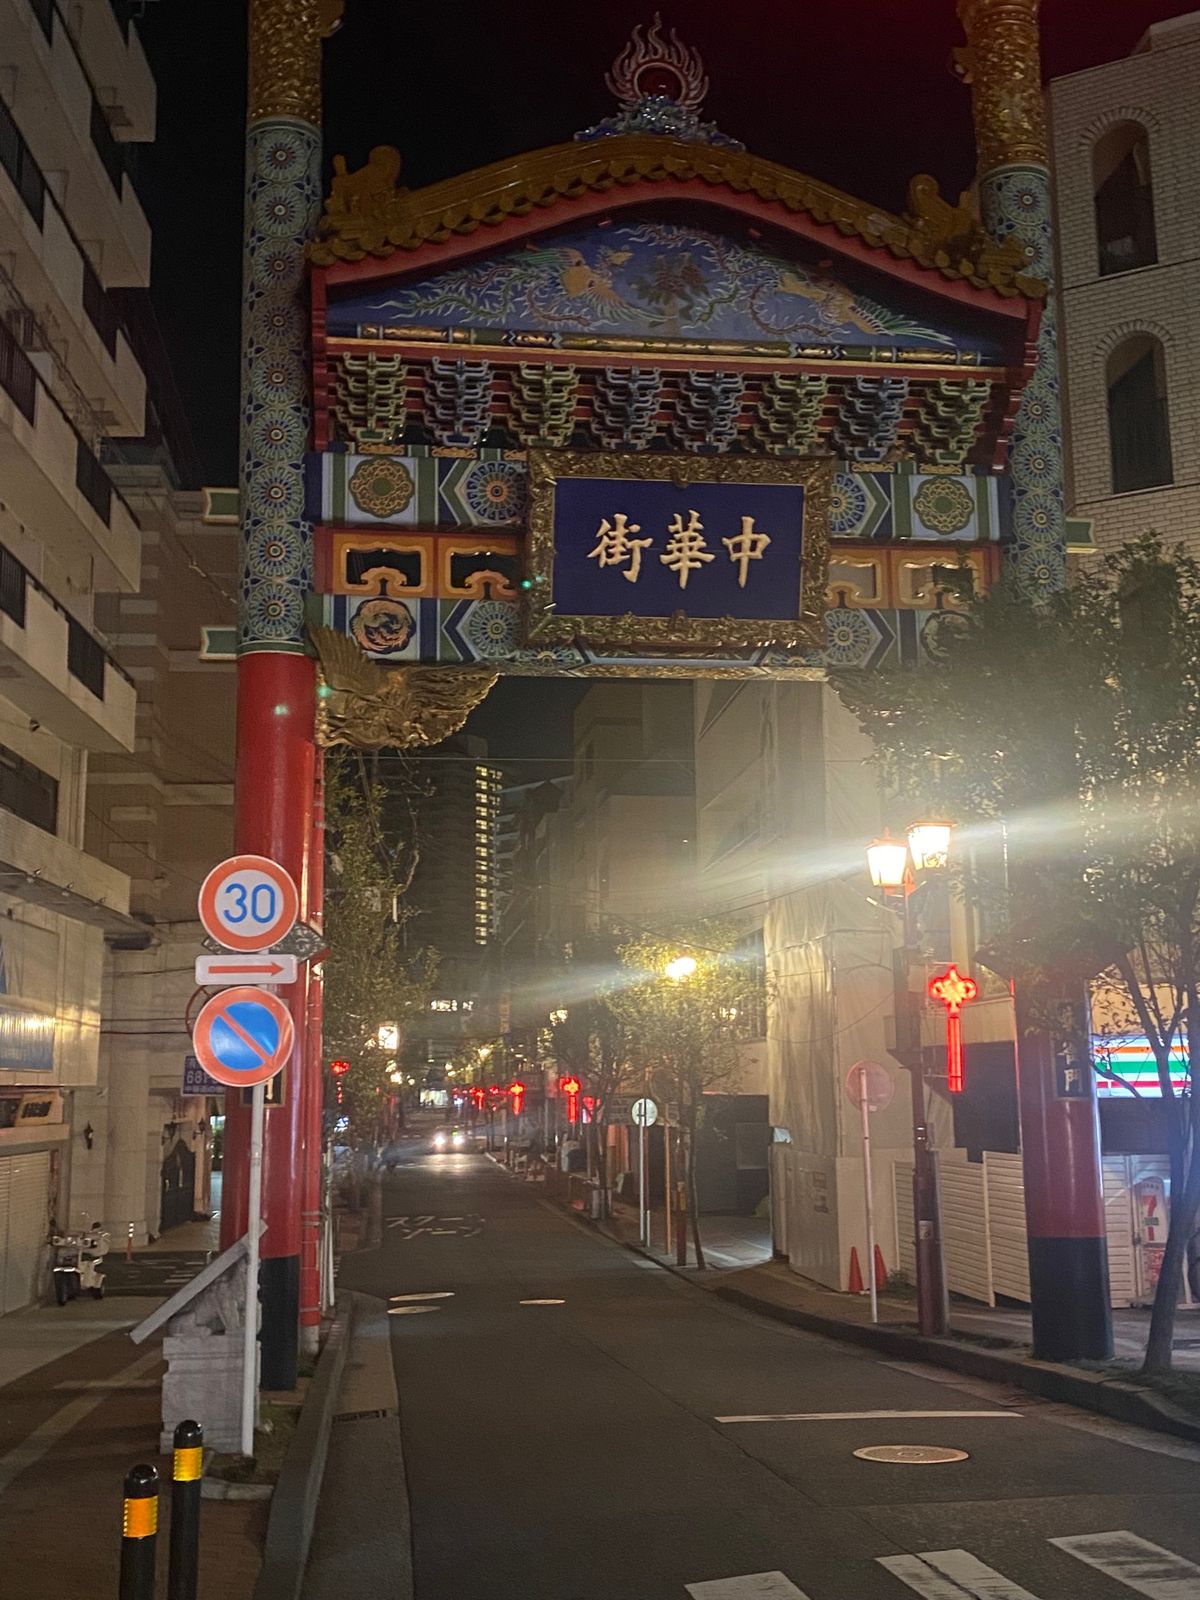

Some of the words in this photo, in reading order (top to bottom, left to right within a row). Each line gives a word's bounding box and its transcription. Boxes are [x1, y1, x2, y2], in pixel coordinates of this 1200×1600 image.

[587, 509, 771, 589] 中華街
[224, 883, 275, 923] 30
